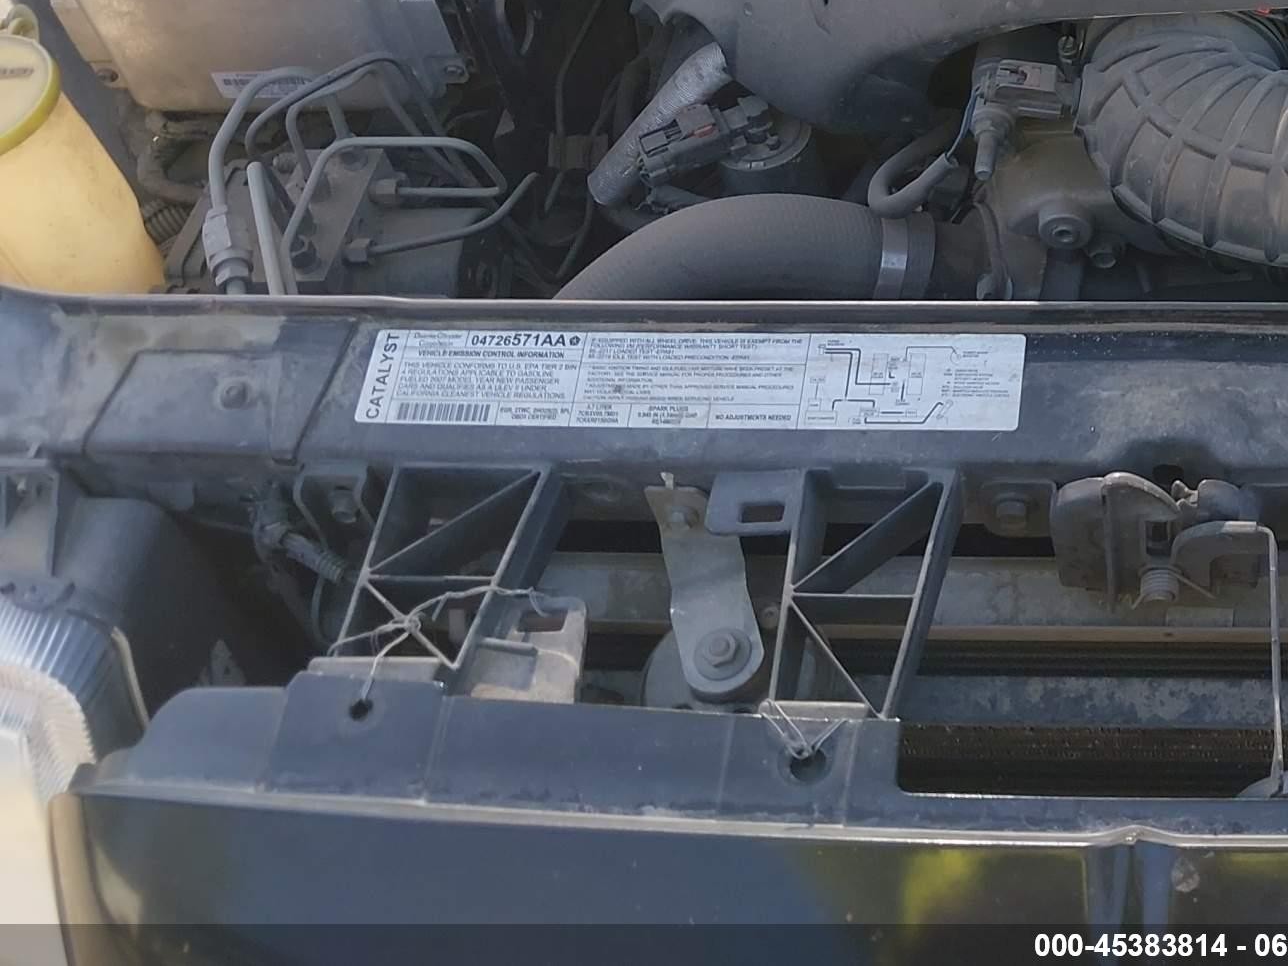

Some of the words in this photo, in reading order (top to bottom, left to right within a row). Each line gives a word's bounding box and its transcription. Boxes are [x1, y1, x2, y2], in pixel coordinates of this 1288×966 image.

[471, 334, 566, 347] 04726571AA
[483, 350, 515, 358] CONTROL
[517, 351, 564, 359] INFORMATION
[366, 333, 400, 419] CATALYST
